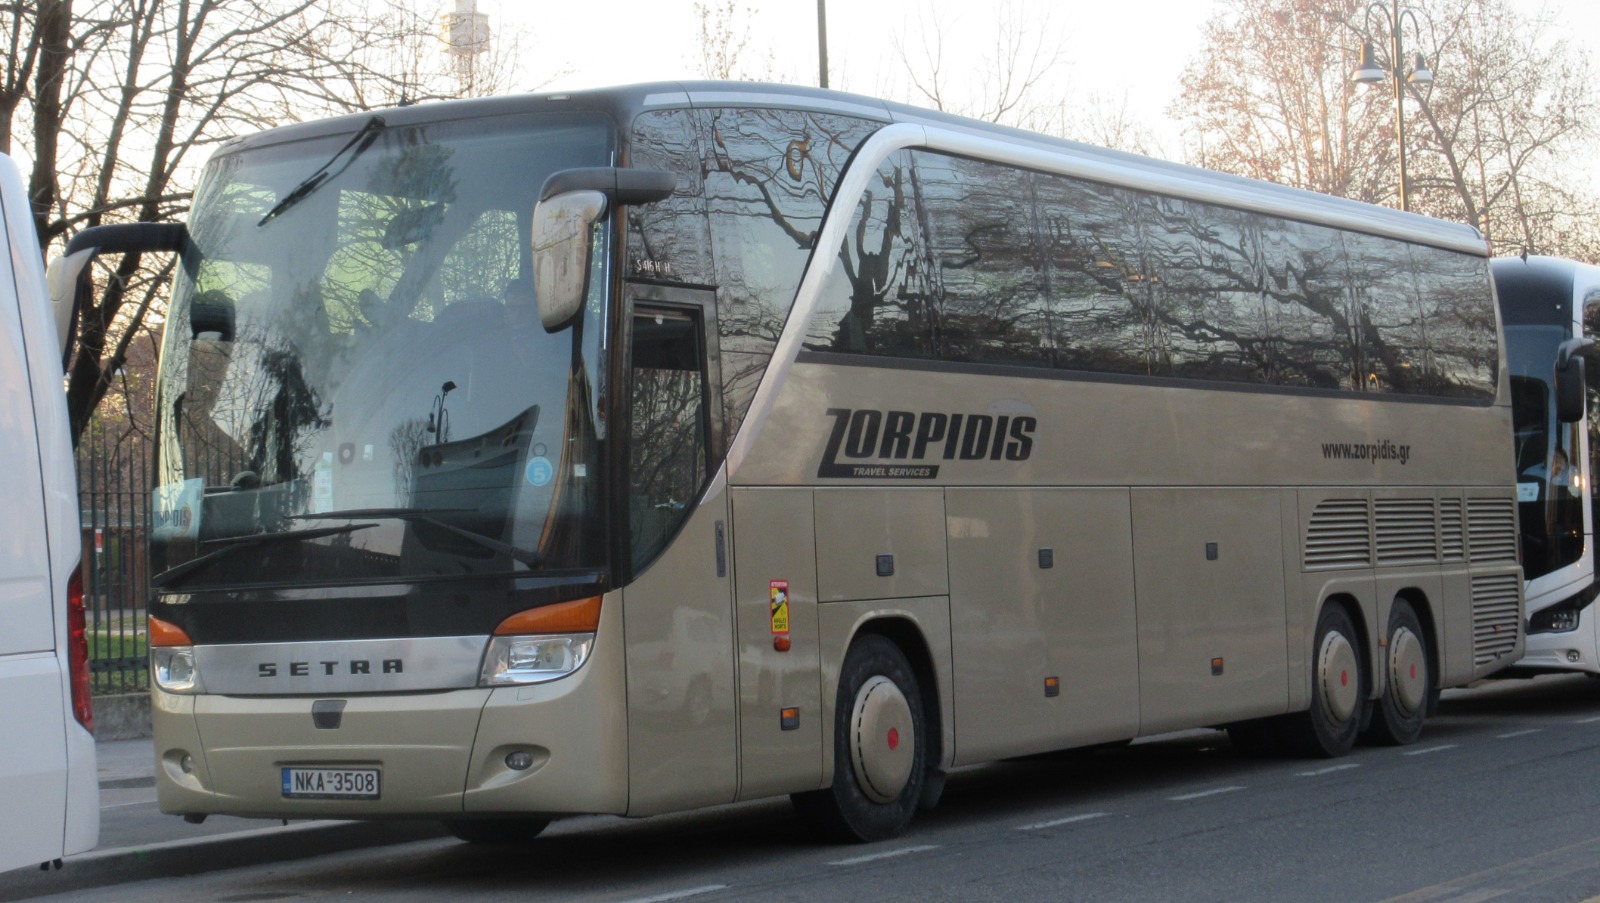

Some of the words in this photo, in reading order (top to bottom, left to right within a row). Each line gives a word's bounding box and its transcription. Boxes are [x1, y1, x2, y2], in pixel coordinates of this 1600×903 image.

[817, 408, 1037, 478] ZORPIDIS
[1322, 439, 1410, 465] www.zorpidis.gr
[534, 466, 545, 480] 5
[853, 467, 886, 476] TRAVEL
[888, 468, 931, 477] SERVICES
[258, 658, 404, 678] SETRA
[295, 771, 375, 792] NKA-3508
